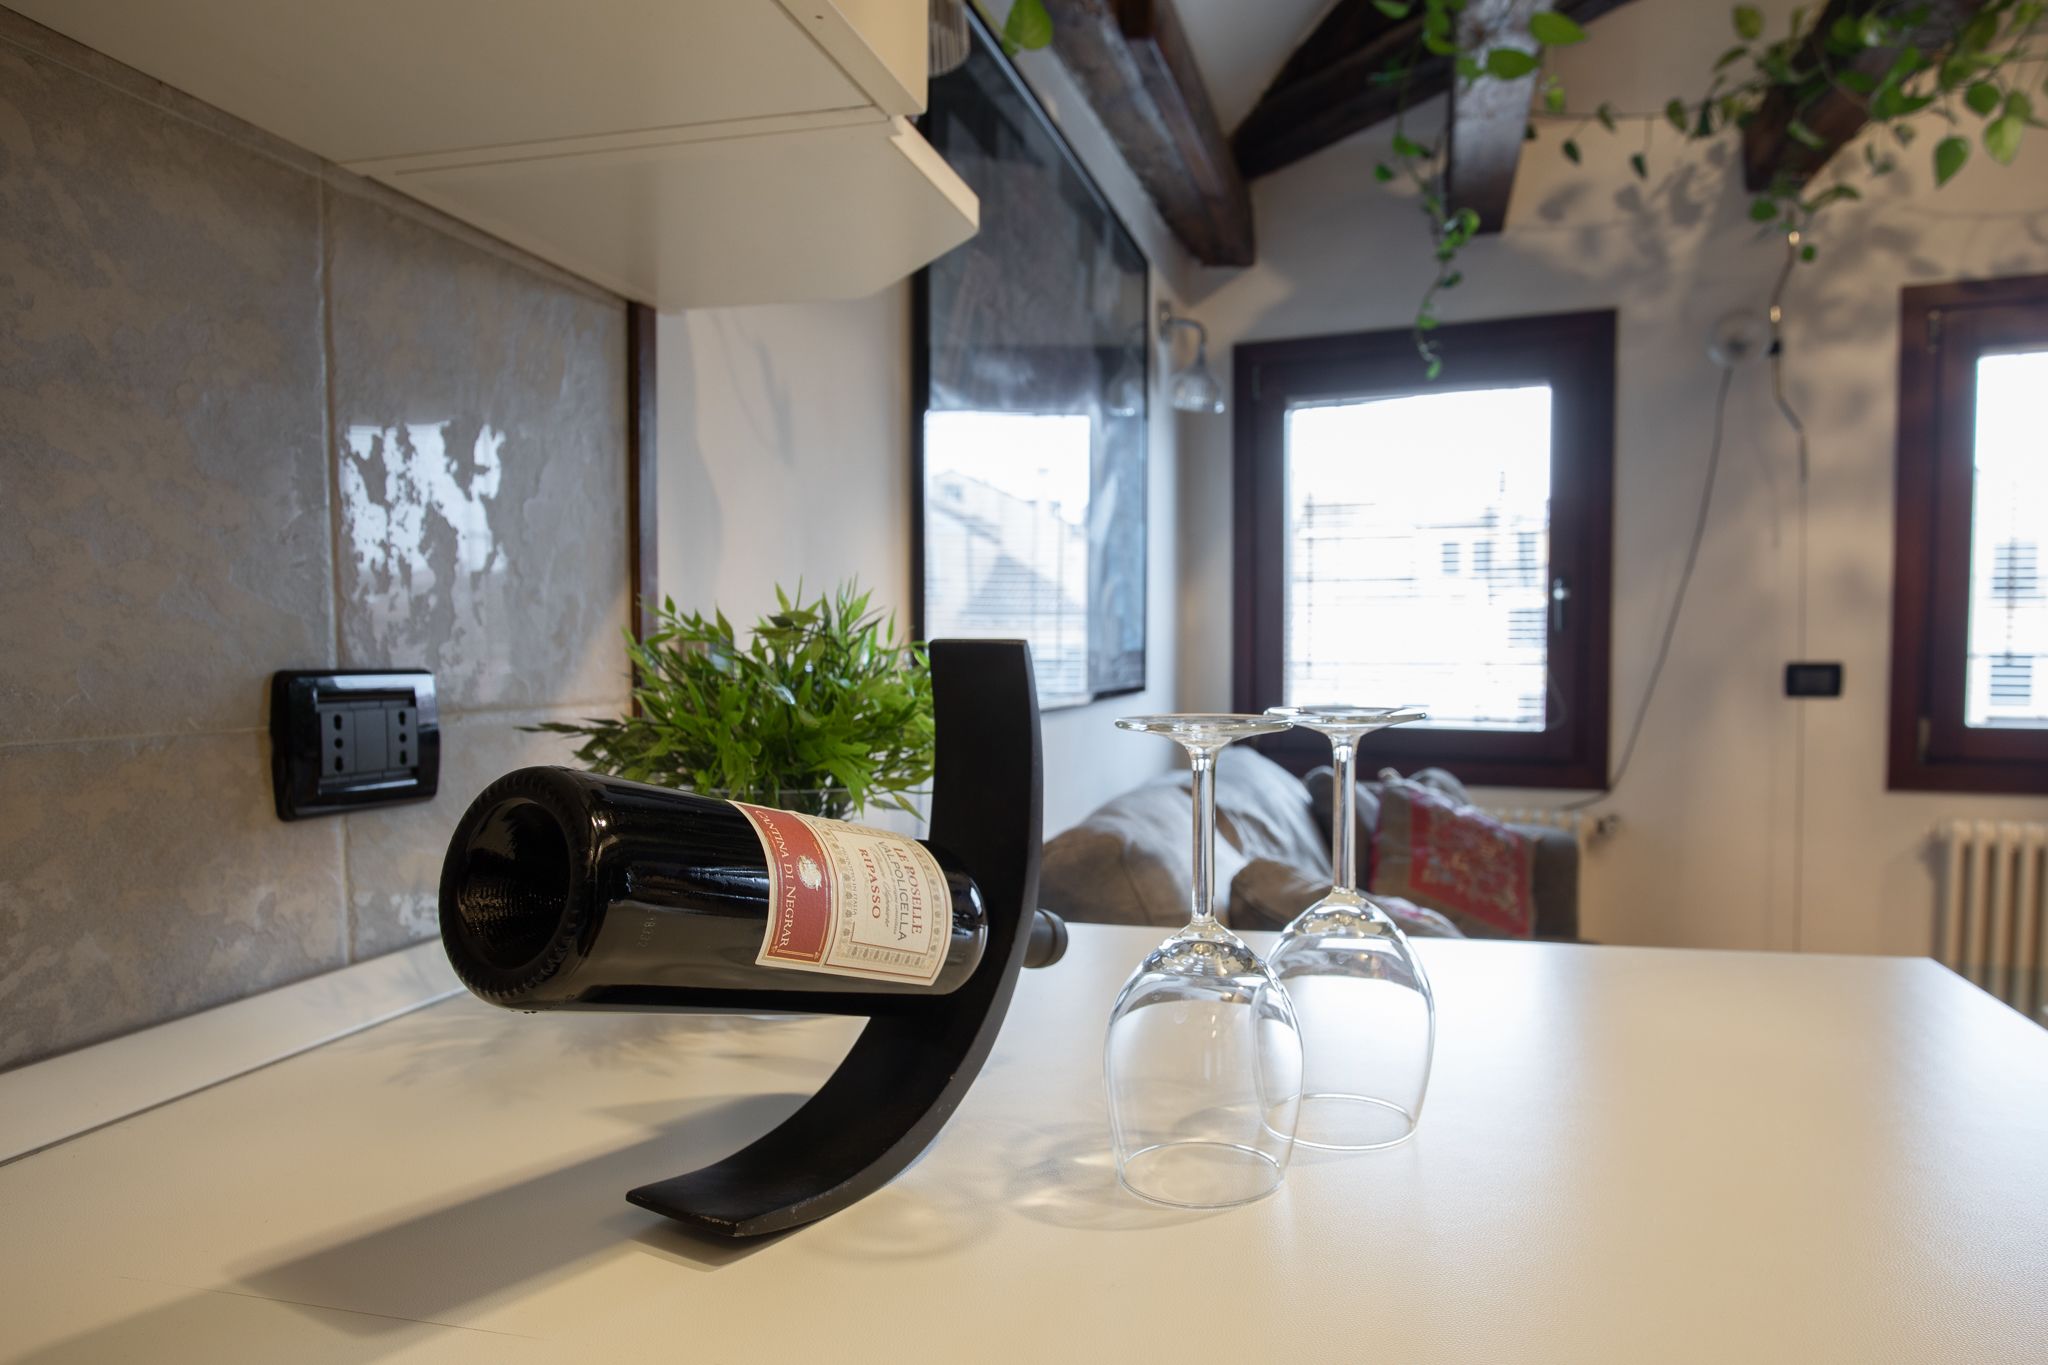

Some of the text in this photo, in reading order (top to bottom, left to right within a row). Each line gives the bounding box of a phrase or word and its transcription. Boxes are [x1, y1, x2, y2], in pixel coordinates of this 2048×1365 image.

[755, 810, 796, 946] CANTINA DI NEGRAR
[859, 848, 880, 919] RIPASSO
[878, 841, 908, 941] VALPOLICELLA
[893, 847, 922, 934] LE ROSELLE
